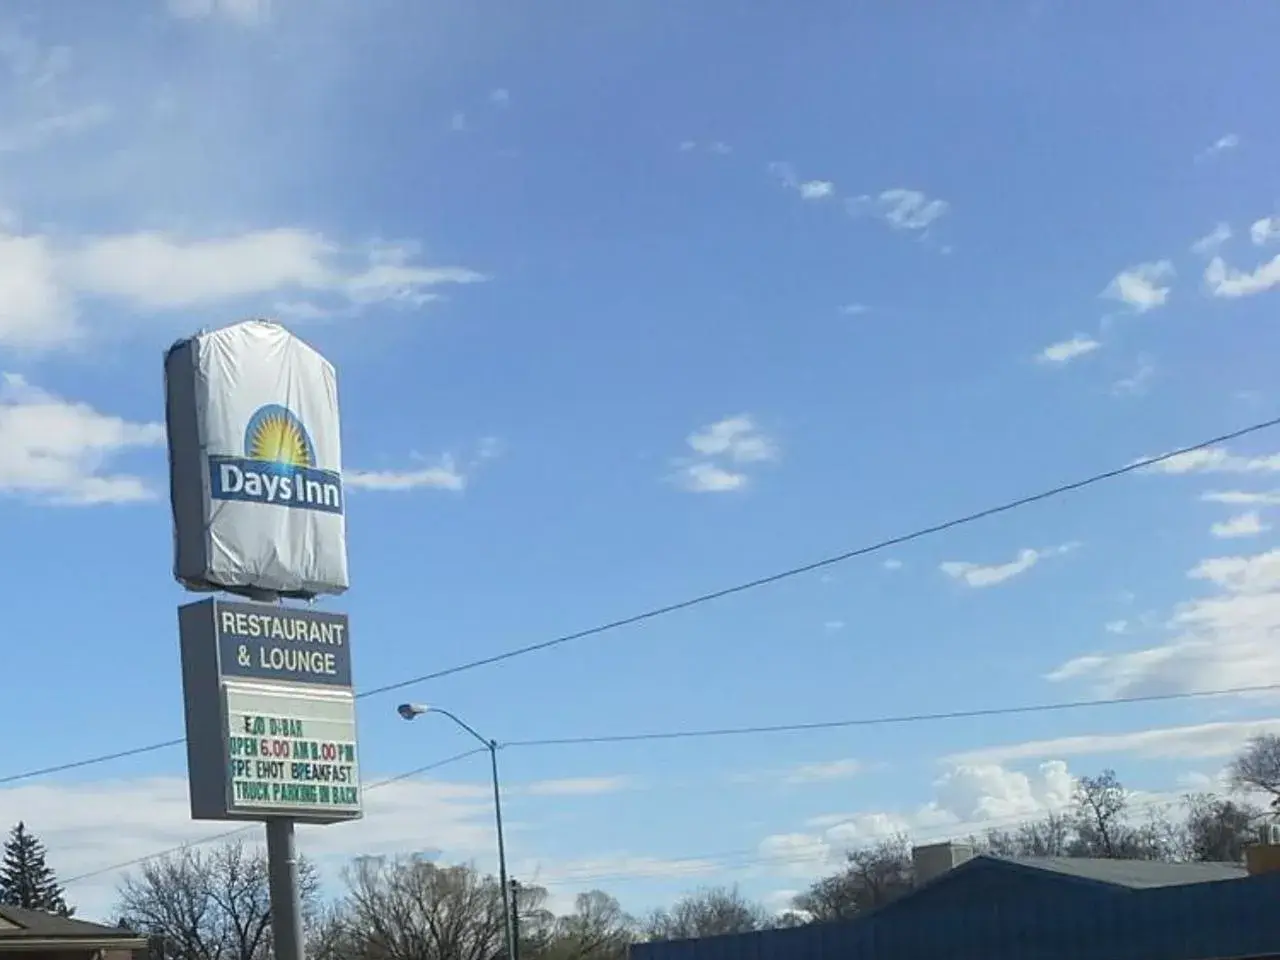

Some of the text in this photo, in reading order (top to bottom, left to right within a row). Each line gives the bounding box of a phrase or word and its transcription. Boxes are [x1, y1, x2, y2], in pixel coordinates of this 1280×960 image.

[219, 464, 340, 508] Days Inn
[221, 611, 345, 646] RESTAURANT
[238, 644, 337, 675] & LOUNGE
[230, 736, 258, 756] OPEN
[235, 781, 269, 801] TRUCK
[273, 782, 318, 803] PARKING
[332, 786, 358, 804] BACK
